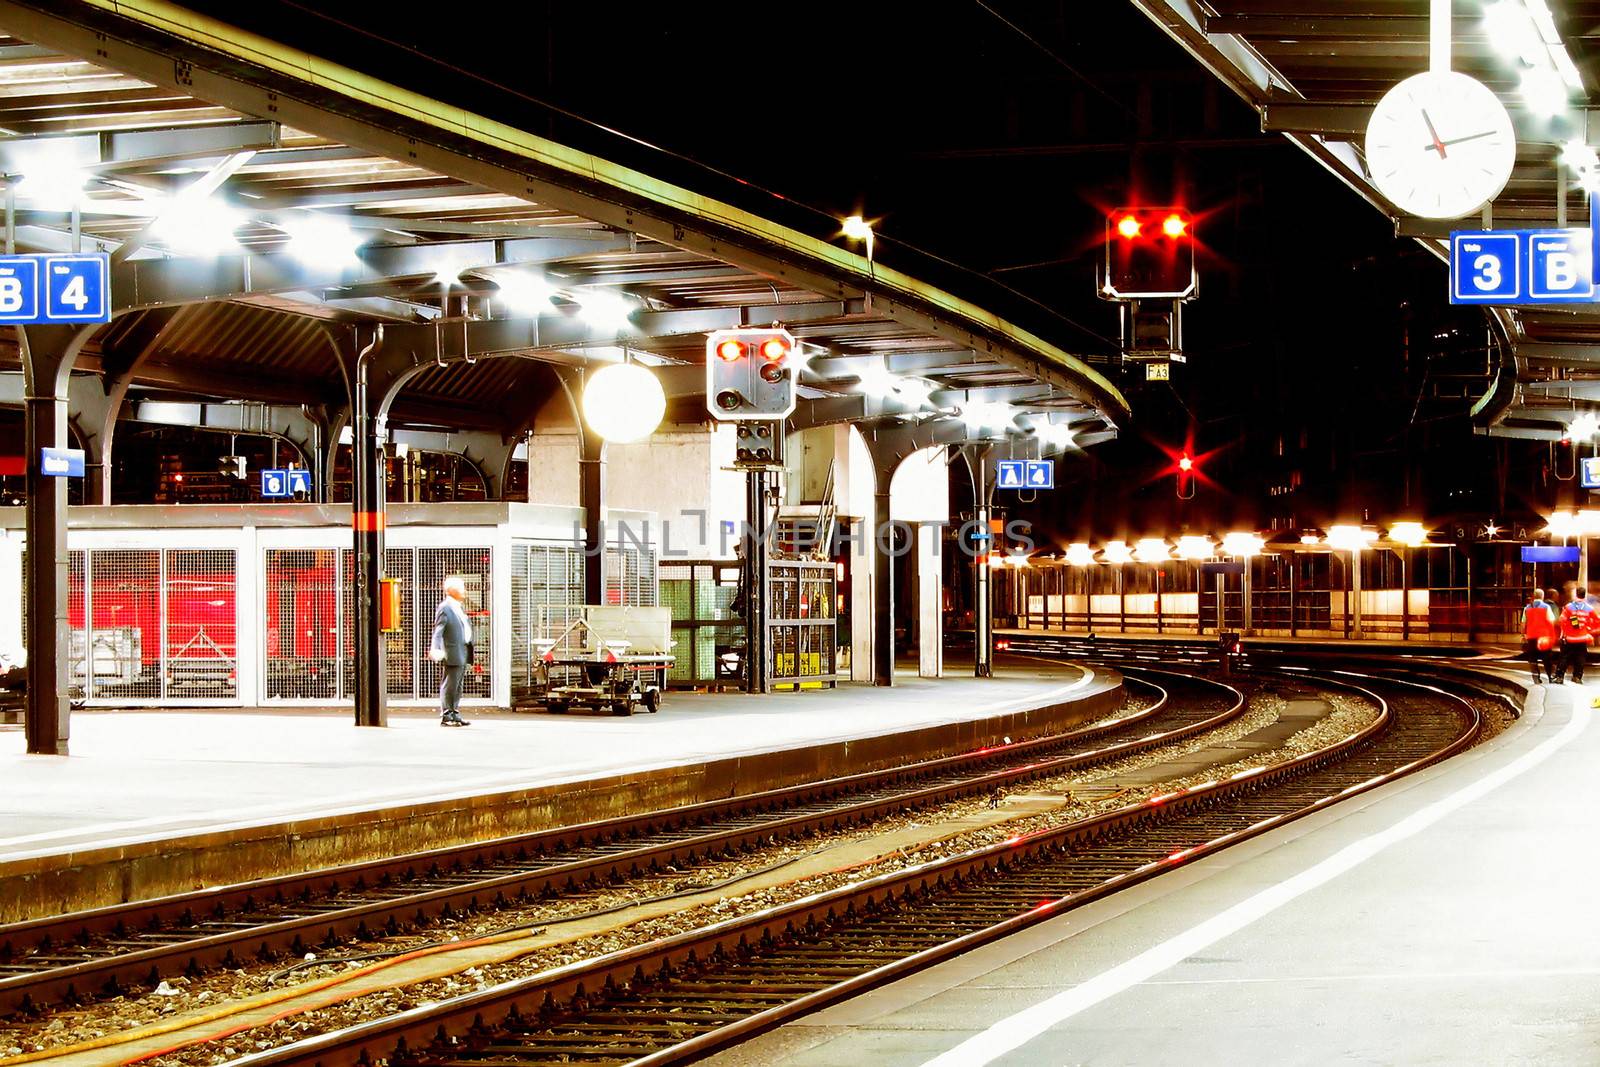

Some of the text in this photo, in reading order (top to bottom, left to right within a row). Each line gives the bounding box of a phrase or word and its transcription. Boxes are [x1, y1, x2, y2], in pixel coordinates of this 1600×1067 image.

[1473, 252, 1578, 291] 3 B
[0, 275, 89, 313] B 4
[1005, 468, 1046, 485] A 4
[268, 477, 306, 493] 6 A
[1456, 527, 1465, 538] 3
[1518, 527, 1527, 538] A
